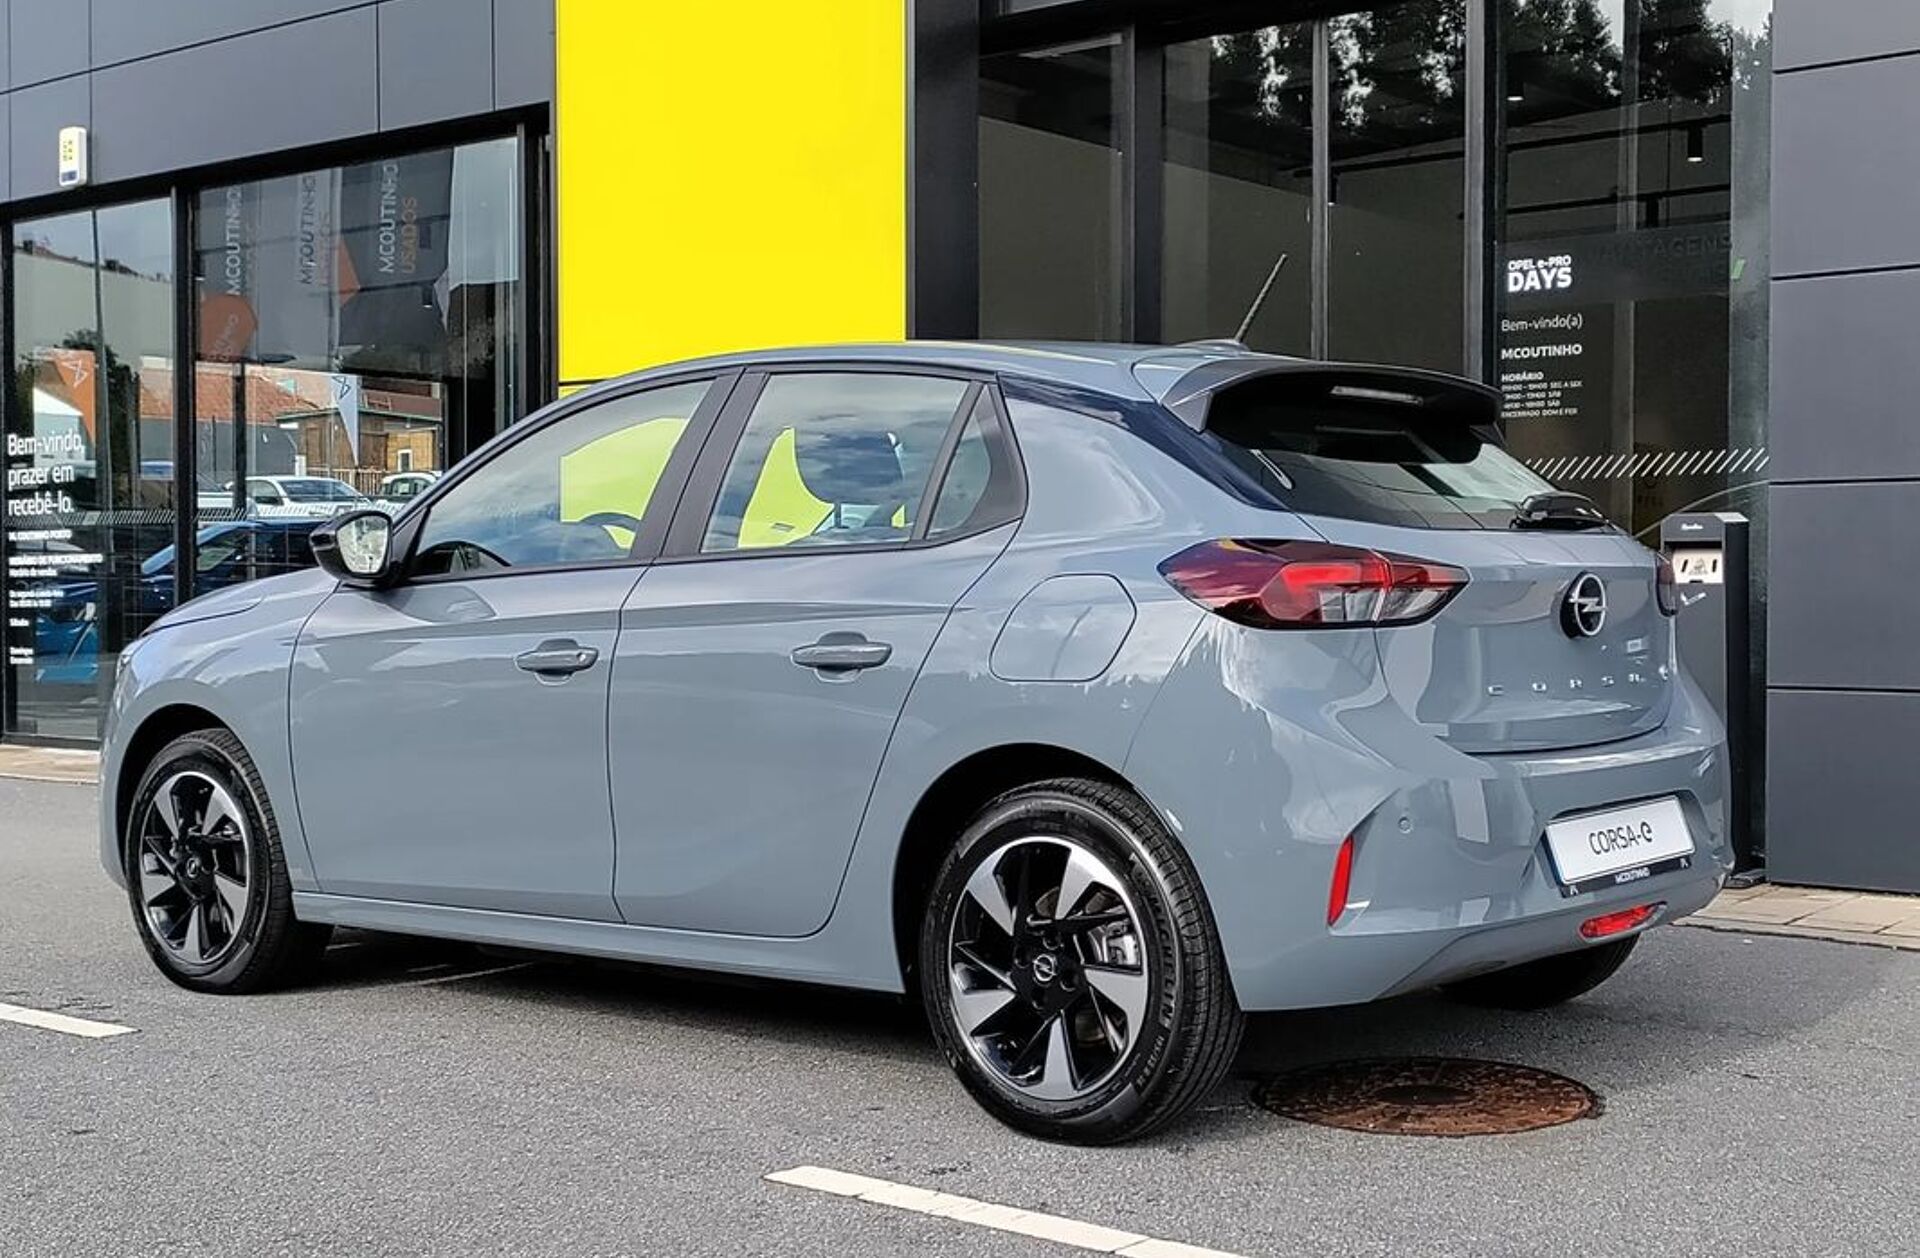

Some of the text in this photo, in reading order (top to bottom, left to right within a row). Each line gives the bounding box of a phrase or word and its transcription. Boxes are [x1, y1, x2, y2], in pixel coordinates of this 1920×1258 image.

[380, 164, 399, 274] MCOUTINHO
[1508, 254, 1572, 271] OPEL e-PRO
[1507, 267, 1573, 292] DAYS
[1501, 312, 1583, 332] Bem-vindo(a)
[1501, 344, 1583, 360] MCOUTINHO
[8, 428, 86, 456] Bem-vindo,
[8, 464, 75, 492] prazer em
[8, 490, 75, 516] recebê-lo.
[1151, 895, 1177, 1029] MICHELIN
